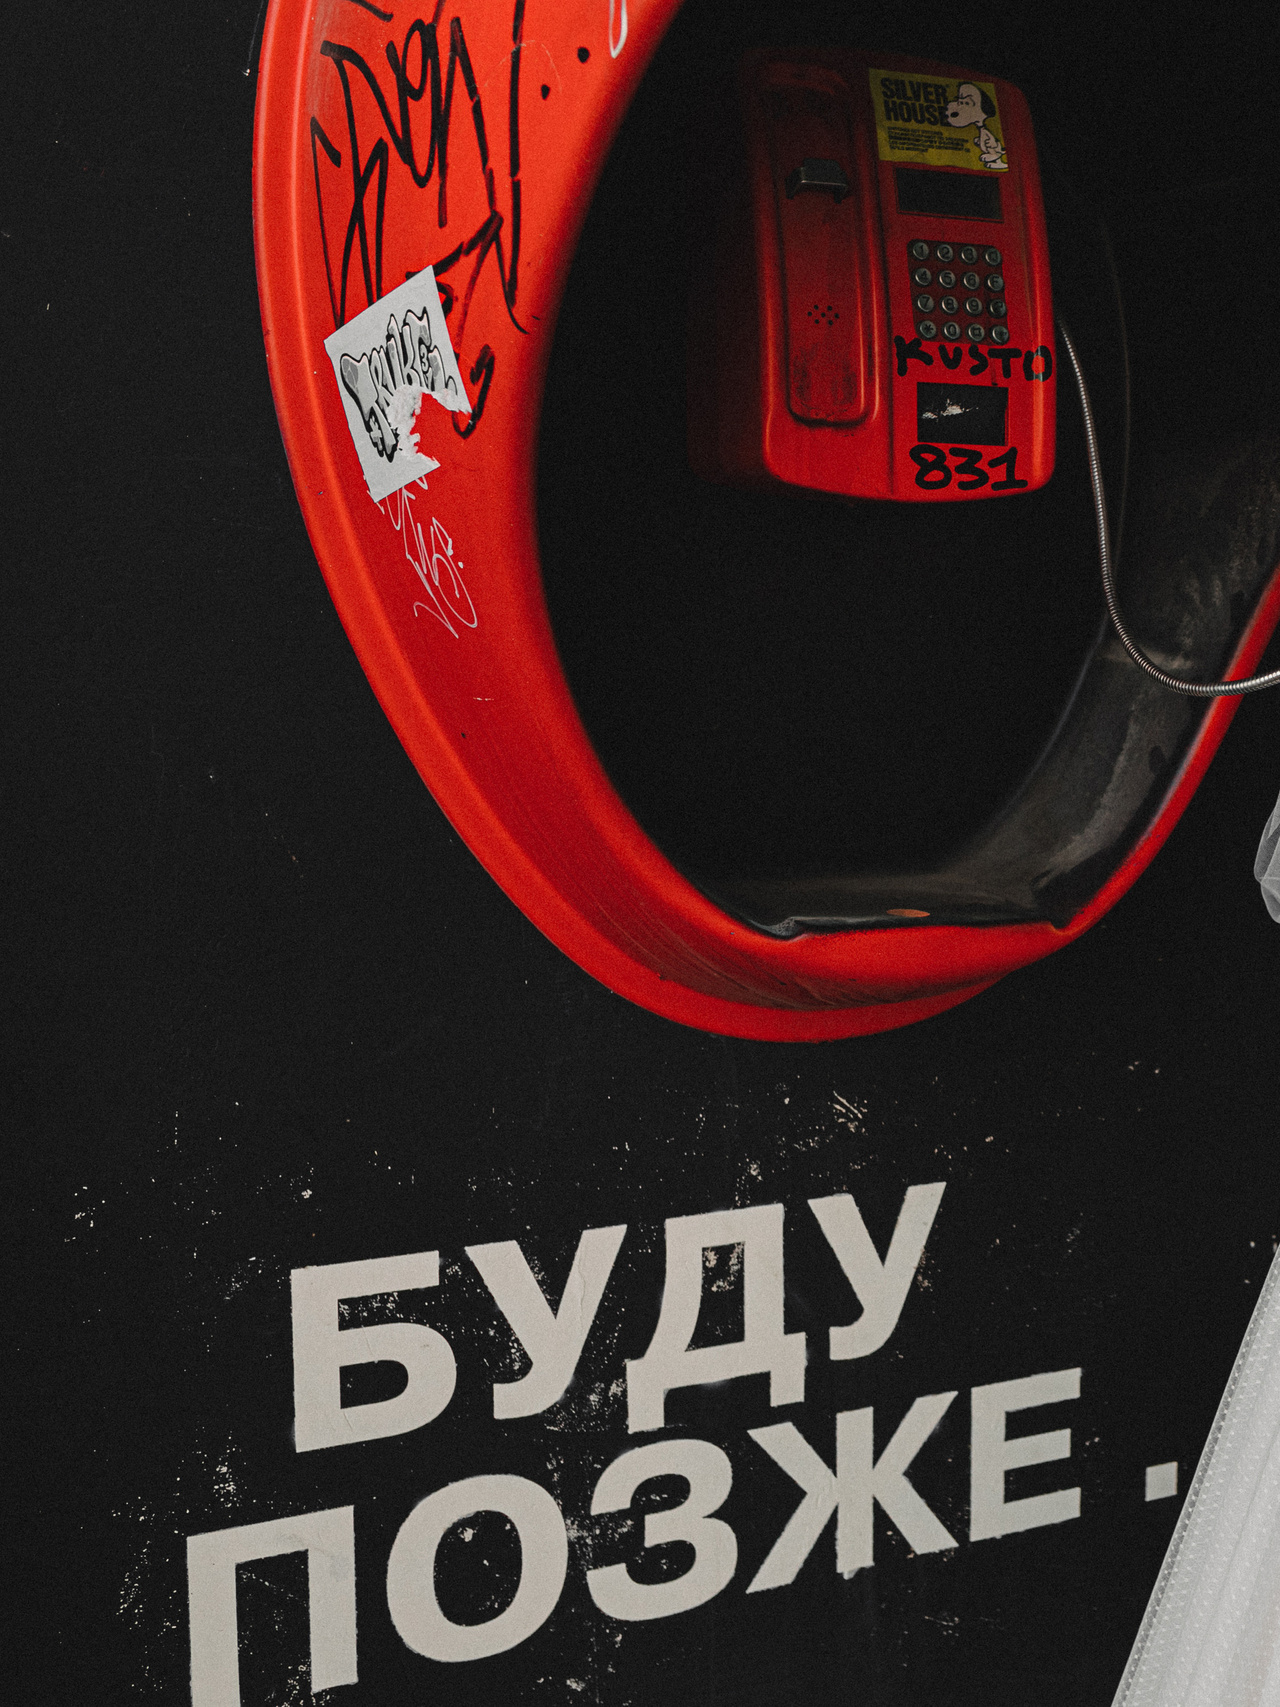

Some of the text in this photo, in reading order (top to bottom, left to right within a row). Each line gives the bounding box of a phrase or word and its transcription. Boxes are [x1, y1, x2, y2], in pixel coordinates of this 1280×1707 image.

[880, 77, 948, 105] SILVER
[883, 99, 952, 127] HOUSE
[908, 443, 1029, 491] 831
[290, 1181, 947, 1453] БУДУ
